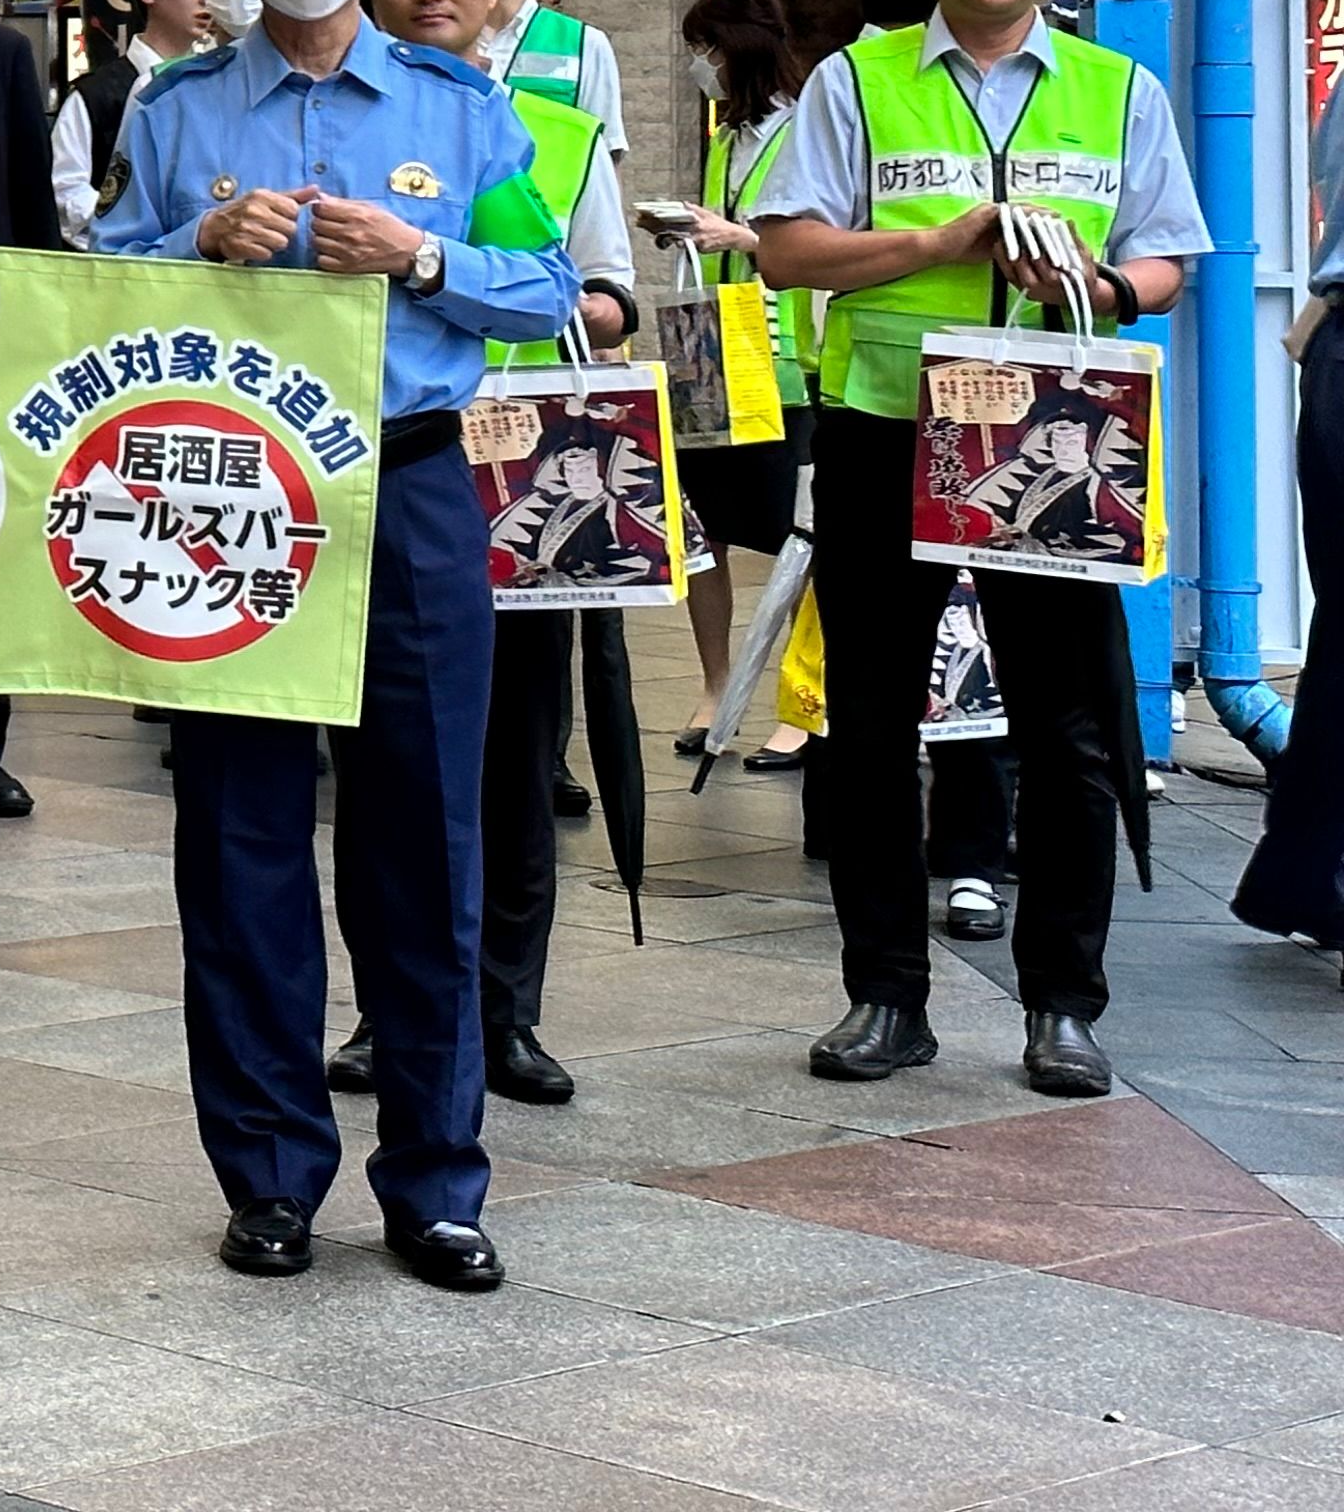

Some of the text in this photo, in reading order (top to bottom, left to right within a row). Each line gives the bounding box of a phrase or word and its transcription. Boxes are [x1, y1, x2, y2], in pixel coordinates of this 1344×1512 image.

[878, 157, 1118, 194] 防犯パトロール
[15, 331, 368, 475] 規制対象を追加
[119, 430, 262, 489] 居酒屋
[47, 491, 327, 550] ガールズバー
[69, 556, 298, 620] スナック等
